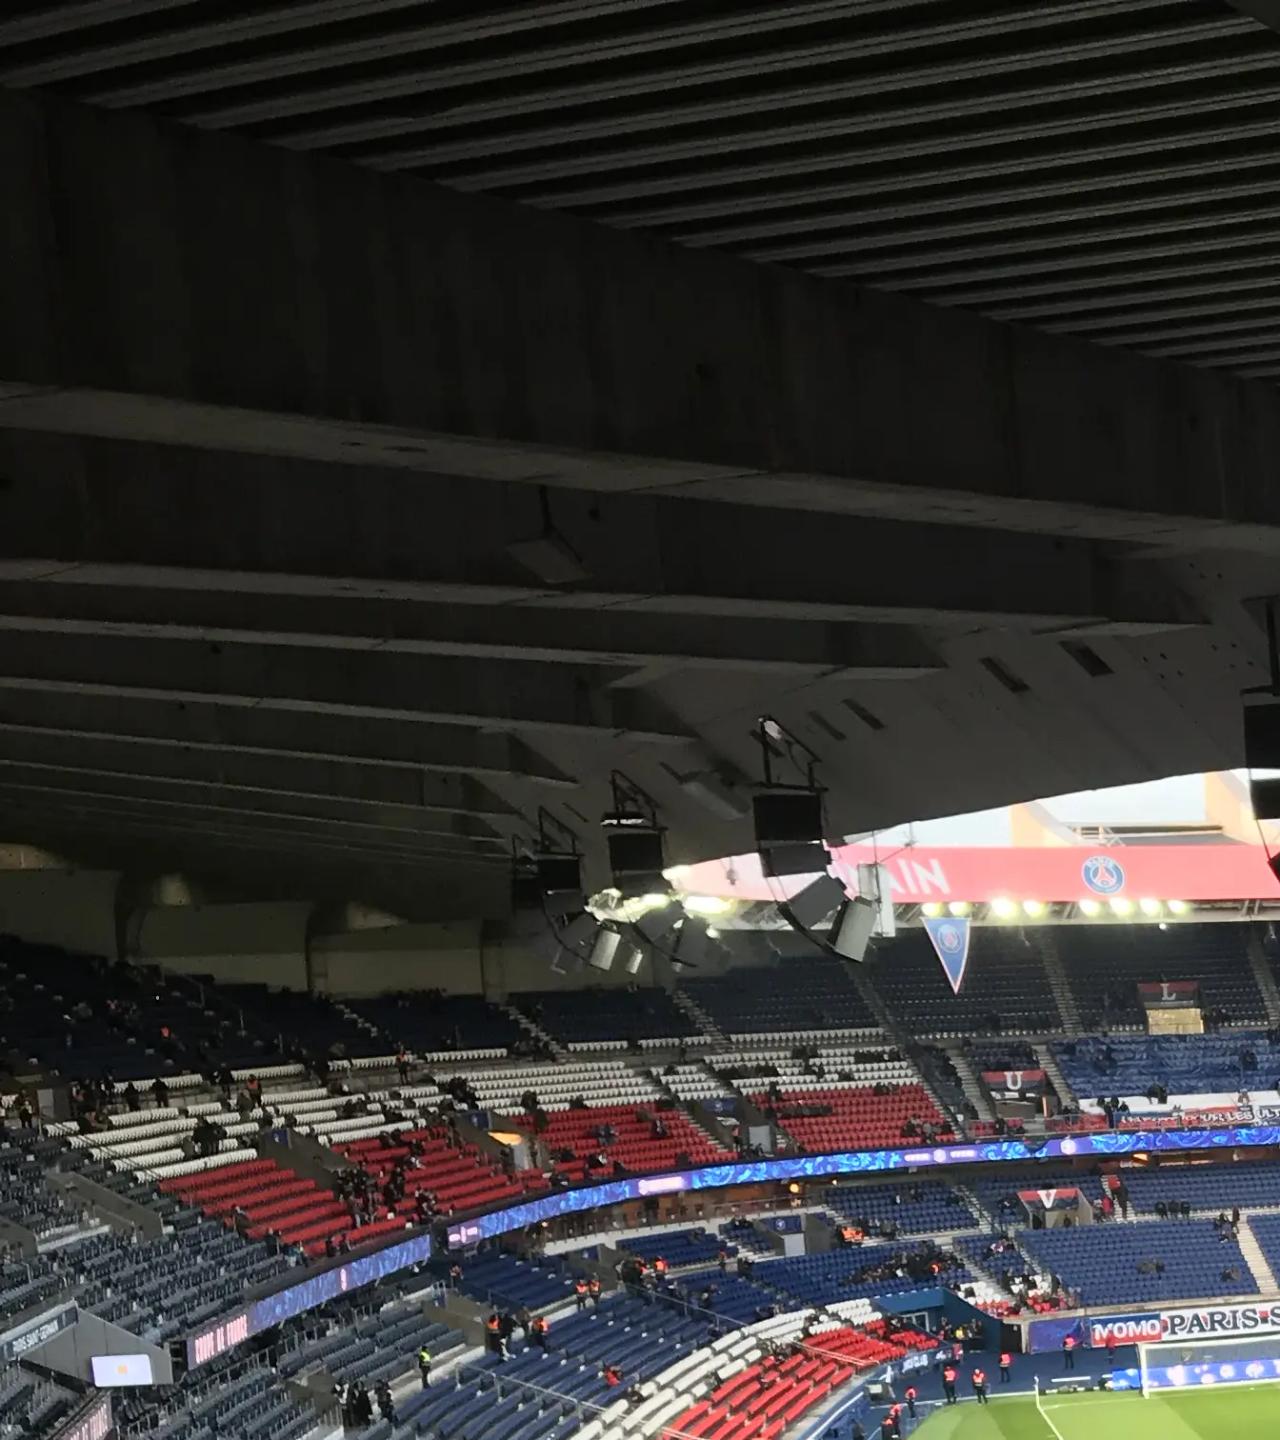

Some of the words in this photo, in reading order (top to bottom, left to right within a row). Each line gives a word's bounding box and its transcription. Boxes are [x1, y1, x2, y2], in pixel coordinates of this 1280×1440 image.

[1160, 983, 1176, 1001] L
[1004, 1071, 1023, 1090] U
[1037, 1190, 1056, 1209] V
[1092, 1319, 1161, 1342] MOMO
